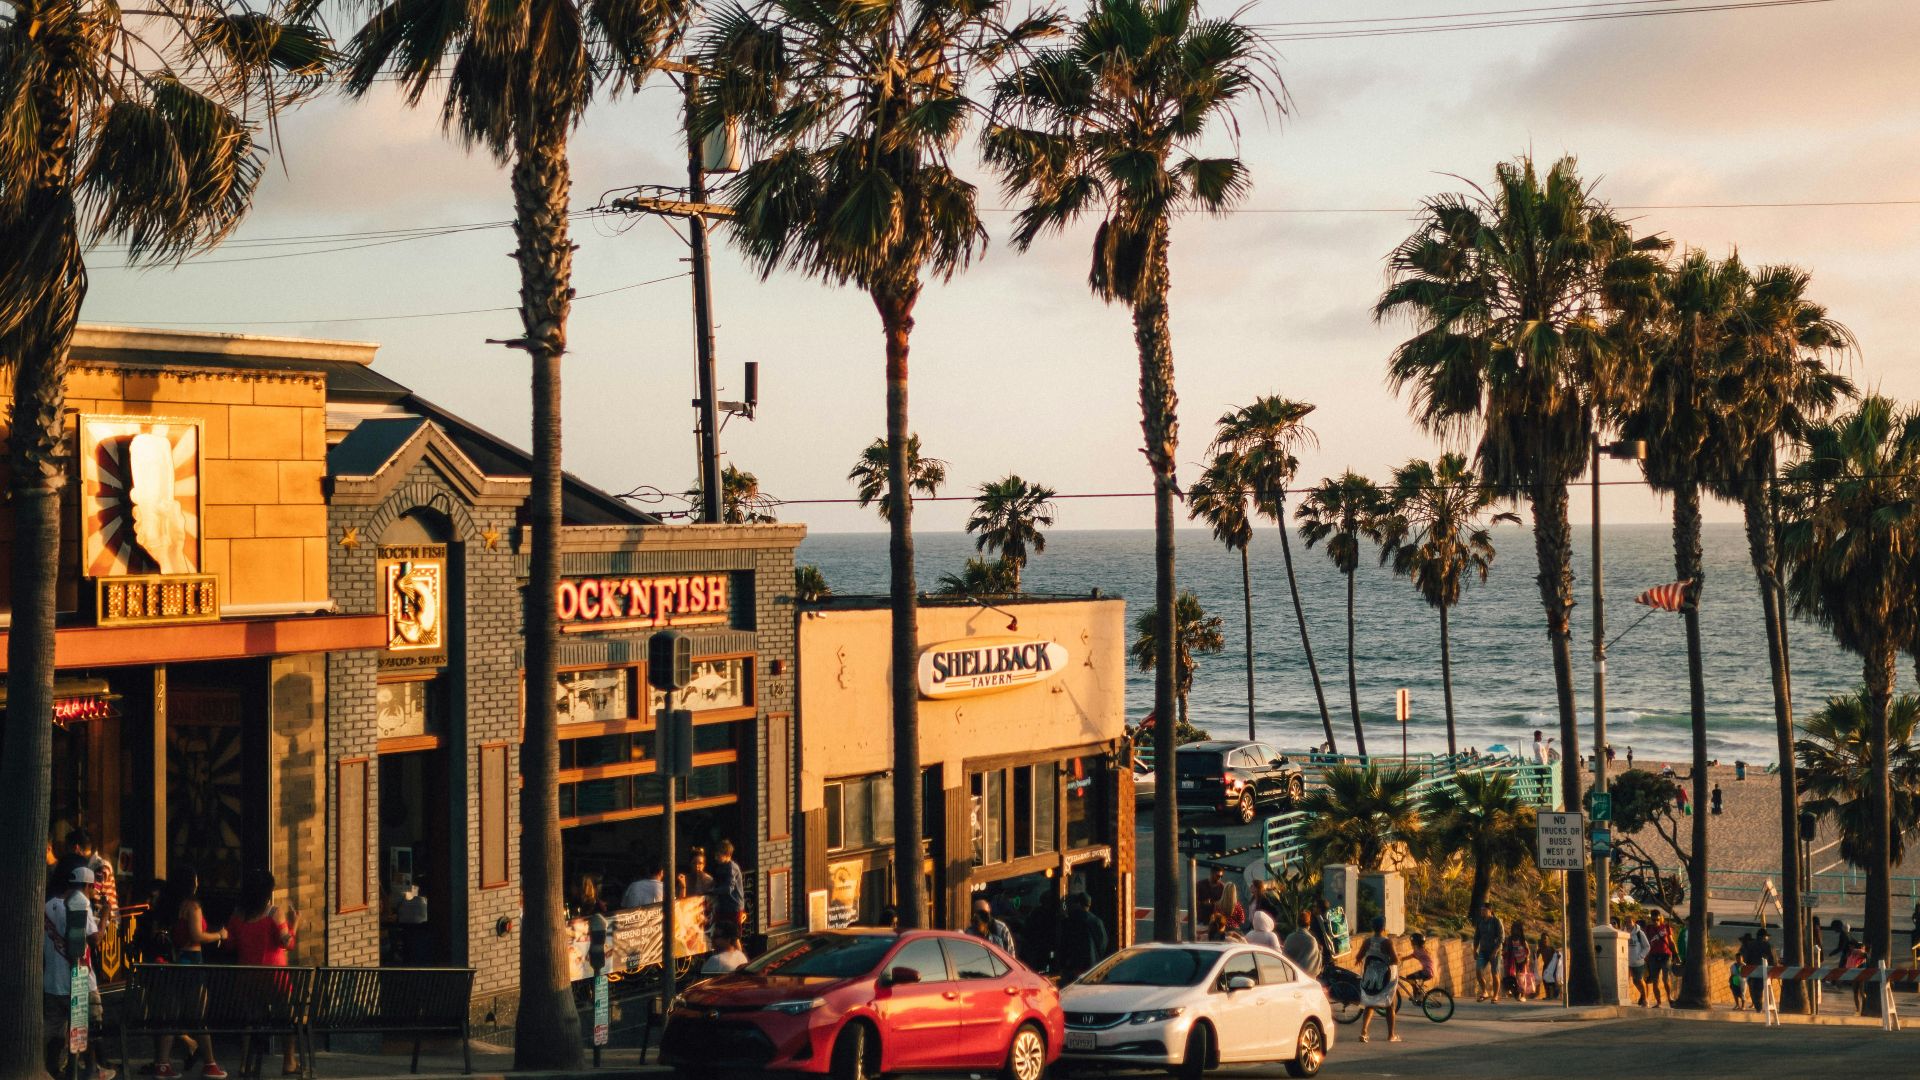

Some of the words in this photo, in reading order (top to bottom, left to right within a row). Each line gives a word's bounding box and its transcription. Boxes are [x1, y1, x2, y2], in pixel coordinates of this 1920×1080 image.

[421, 545, 446, 558] FISH
[108, 583, 213, 618] BREWCO
[557, 579, 651, 620] OCK'N
[653, 576, 727, 627] FISH
[932, 642, 1052, 684] SHELLBACK
[971, 673, 1013, 688] TAVERN
[1553, 816, 1566, 825] NO
[1541, 827, 1568, 835] TRUCKS
[1546, 848, 1564, 856] WEST
[1543, 858, 1565, 866] OCEAN
